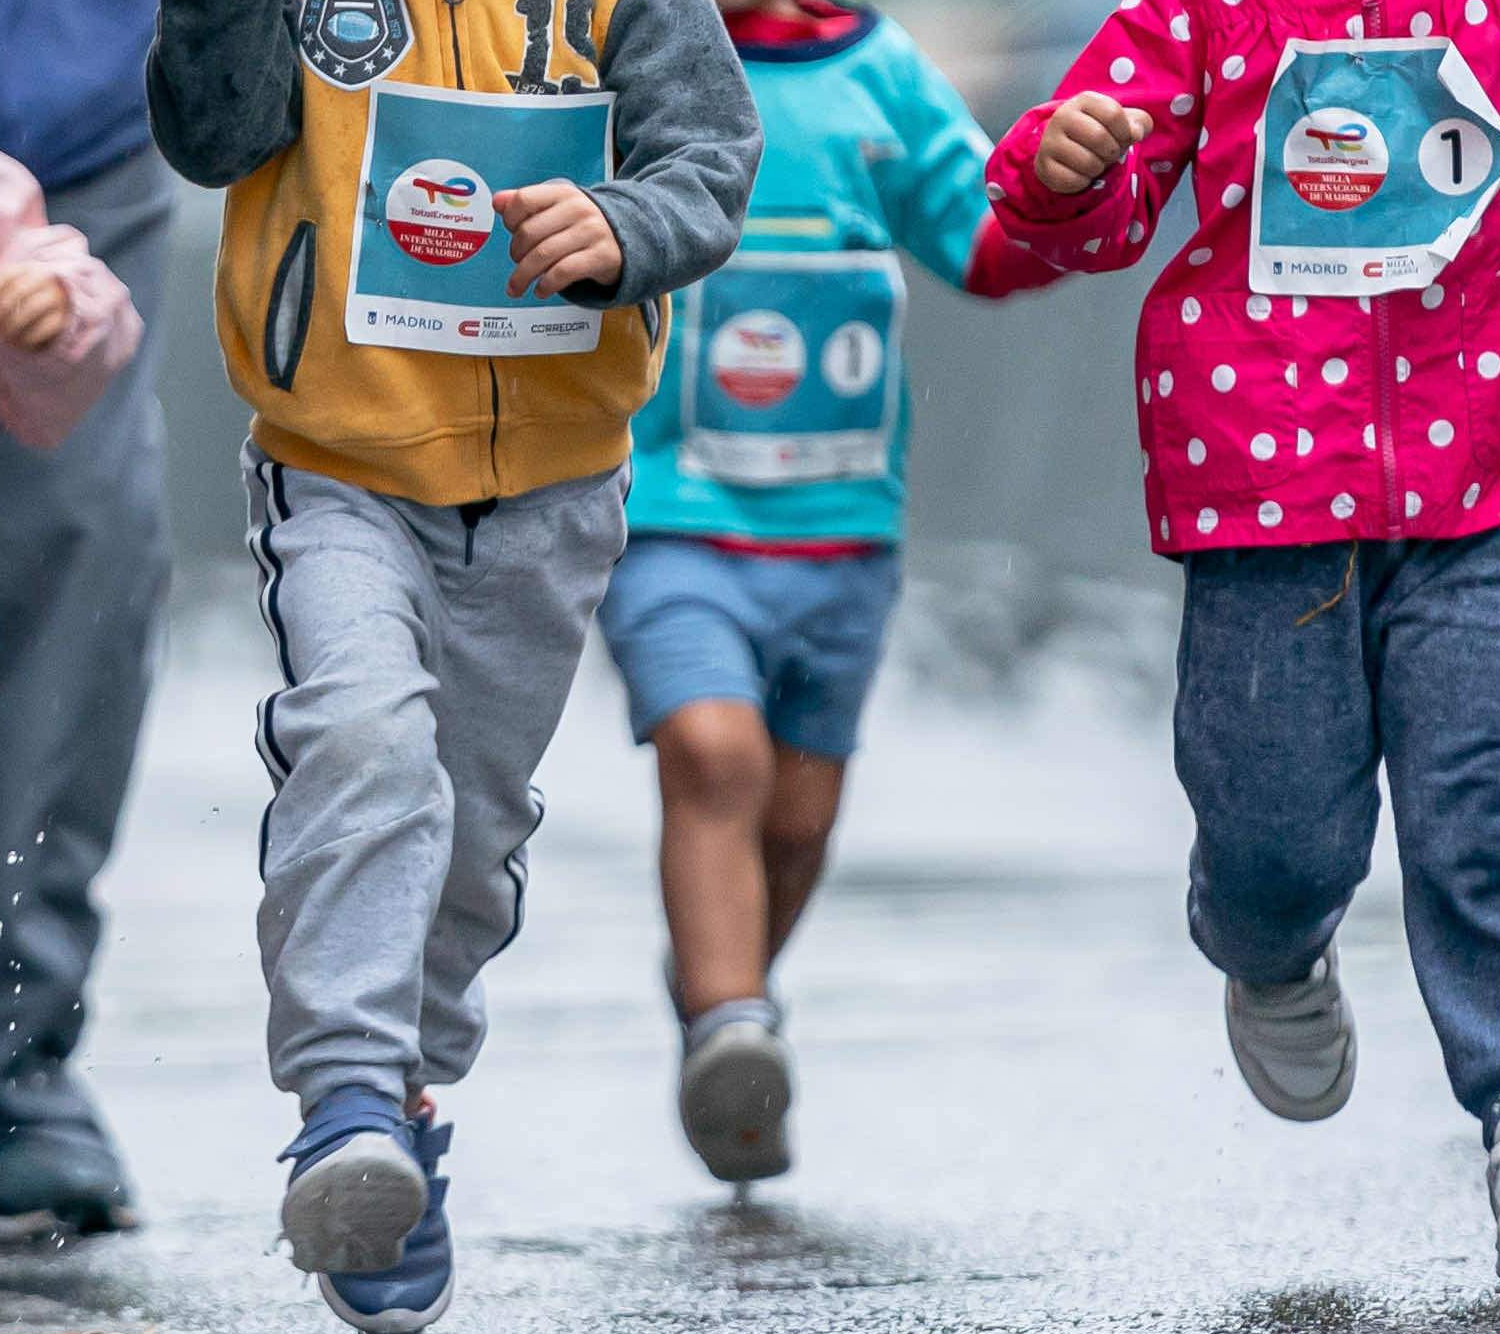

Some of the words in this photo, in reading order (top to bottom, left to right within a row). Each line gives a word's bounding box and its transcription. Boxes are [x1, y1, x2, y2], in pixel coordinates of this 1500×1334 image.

[1308, 155, 1369, 167] TotalEnergies
[1439, 128, 1463, 185] 1
[1321, 174, 1351, 183] MILLA
[1309, 193, 1323, 201] DE
[411, 207, 474, 224] TotalEnergies
[424, 227, 454, 239] MILLA
[410, 245, 424, 255] DE
[426, 247, 464, 260] MADRID
[1290, 262, 1348, 275] MADRID
[385, 314, 443, 331] MADRID
[483, 320, 513, 329] MILLA
